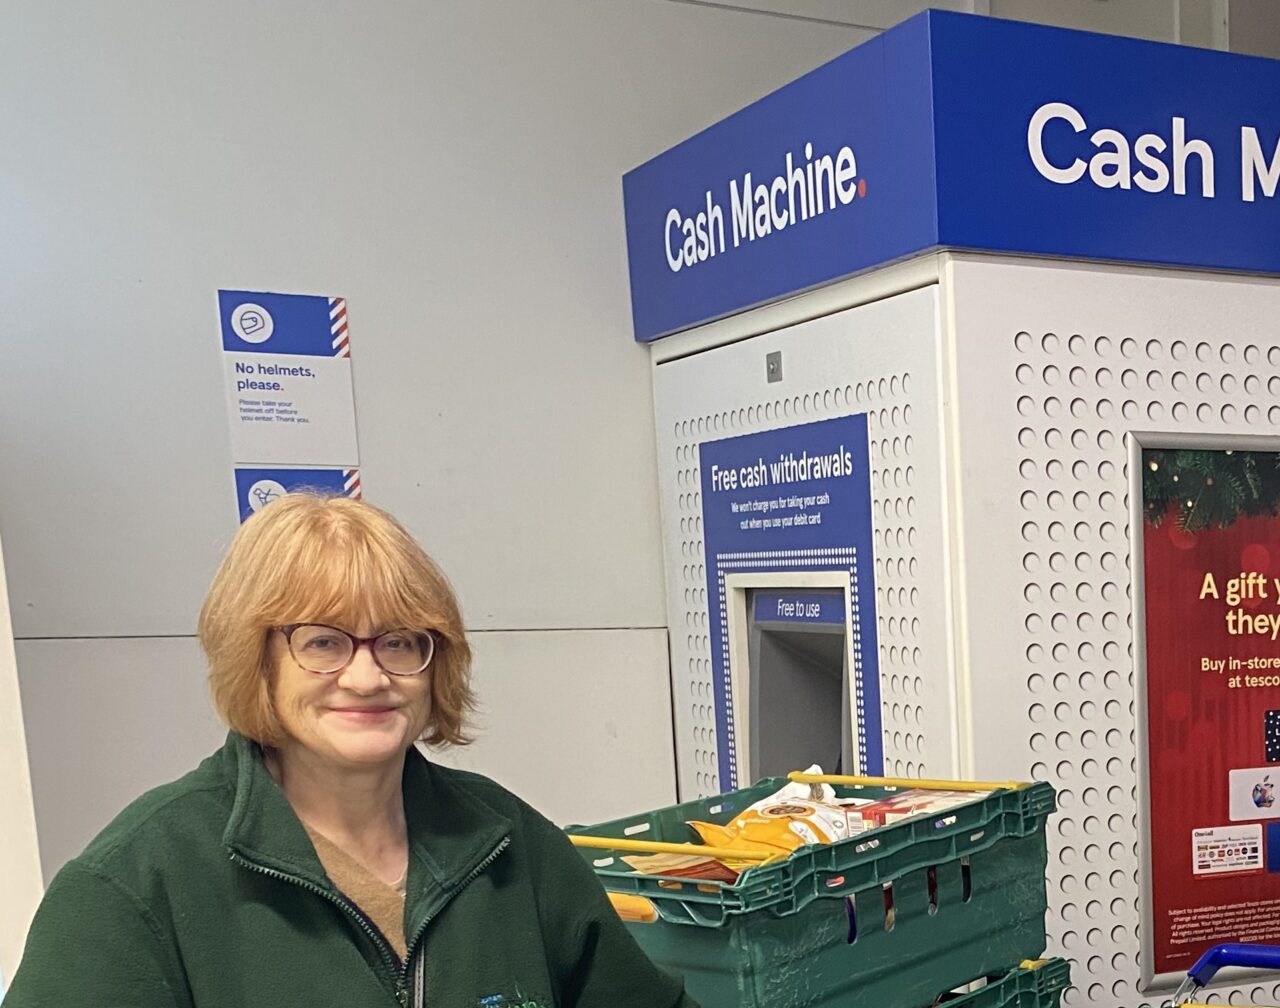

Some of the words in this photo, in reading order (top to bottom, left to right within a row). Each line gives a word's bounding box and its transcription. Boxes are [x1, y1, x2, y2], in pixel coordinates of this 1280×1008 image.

[1026, 101, 1217, 200] Cash
[663, 192, 728, 274] Cash
[730, 142, 867, 250] Machine.
[235, 363, 255, 375] No
[258, 363, 316, 379] helmets,
[237, 379, 285, 392] please.
[711, 465, 737, 492] Free
[740, 458, 768, 488] cash
[770, 445, 853, 484] withdrawals
[816, 491, 830, 506] cash
[808, 511, 822, 525] card
[1199, 572, 1219, 600] A
[1226, 572, 1268, 607] gift
[777, 599, 794, 617] Free
[796, 600, 804, 617] to
[805, 603, 821, 618] use
[1201, 656, 1226, 673] Buy
[1229, 655, 1280, 671] in-store
[1228, 674, 1241, 688] at
